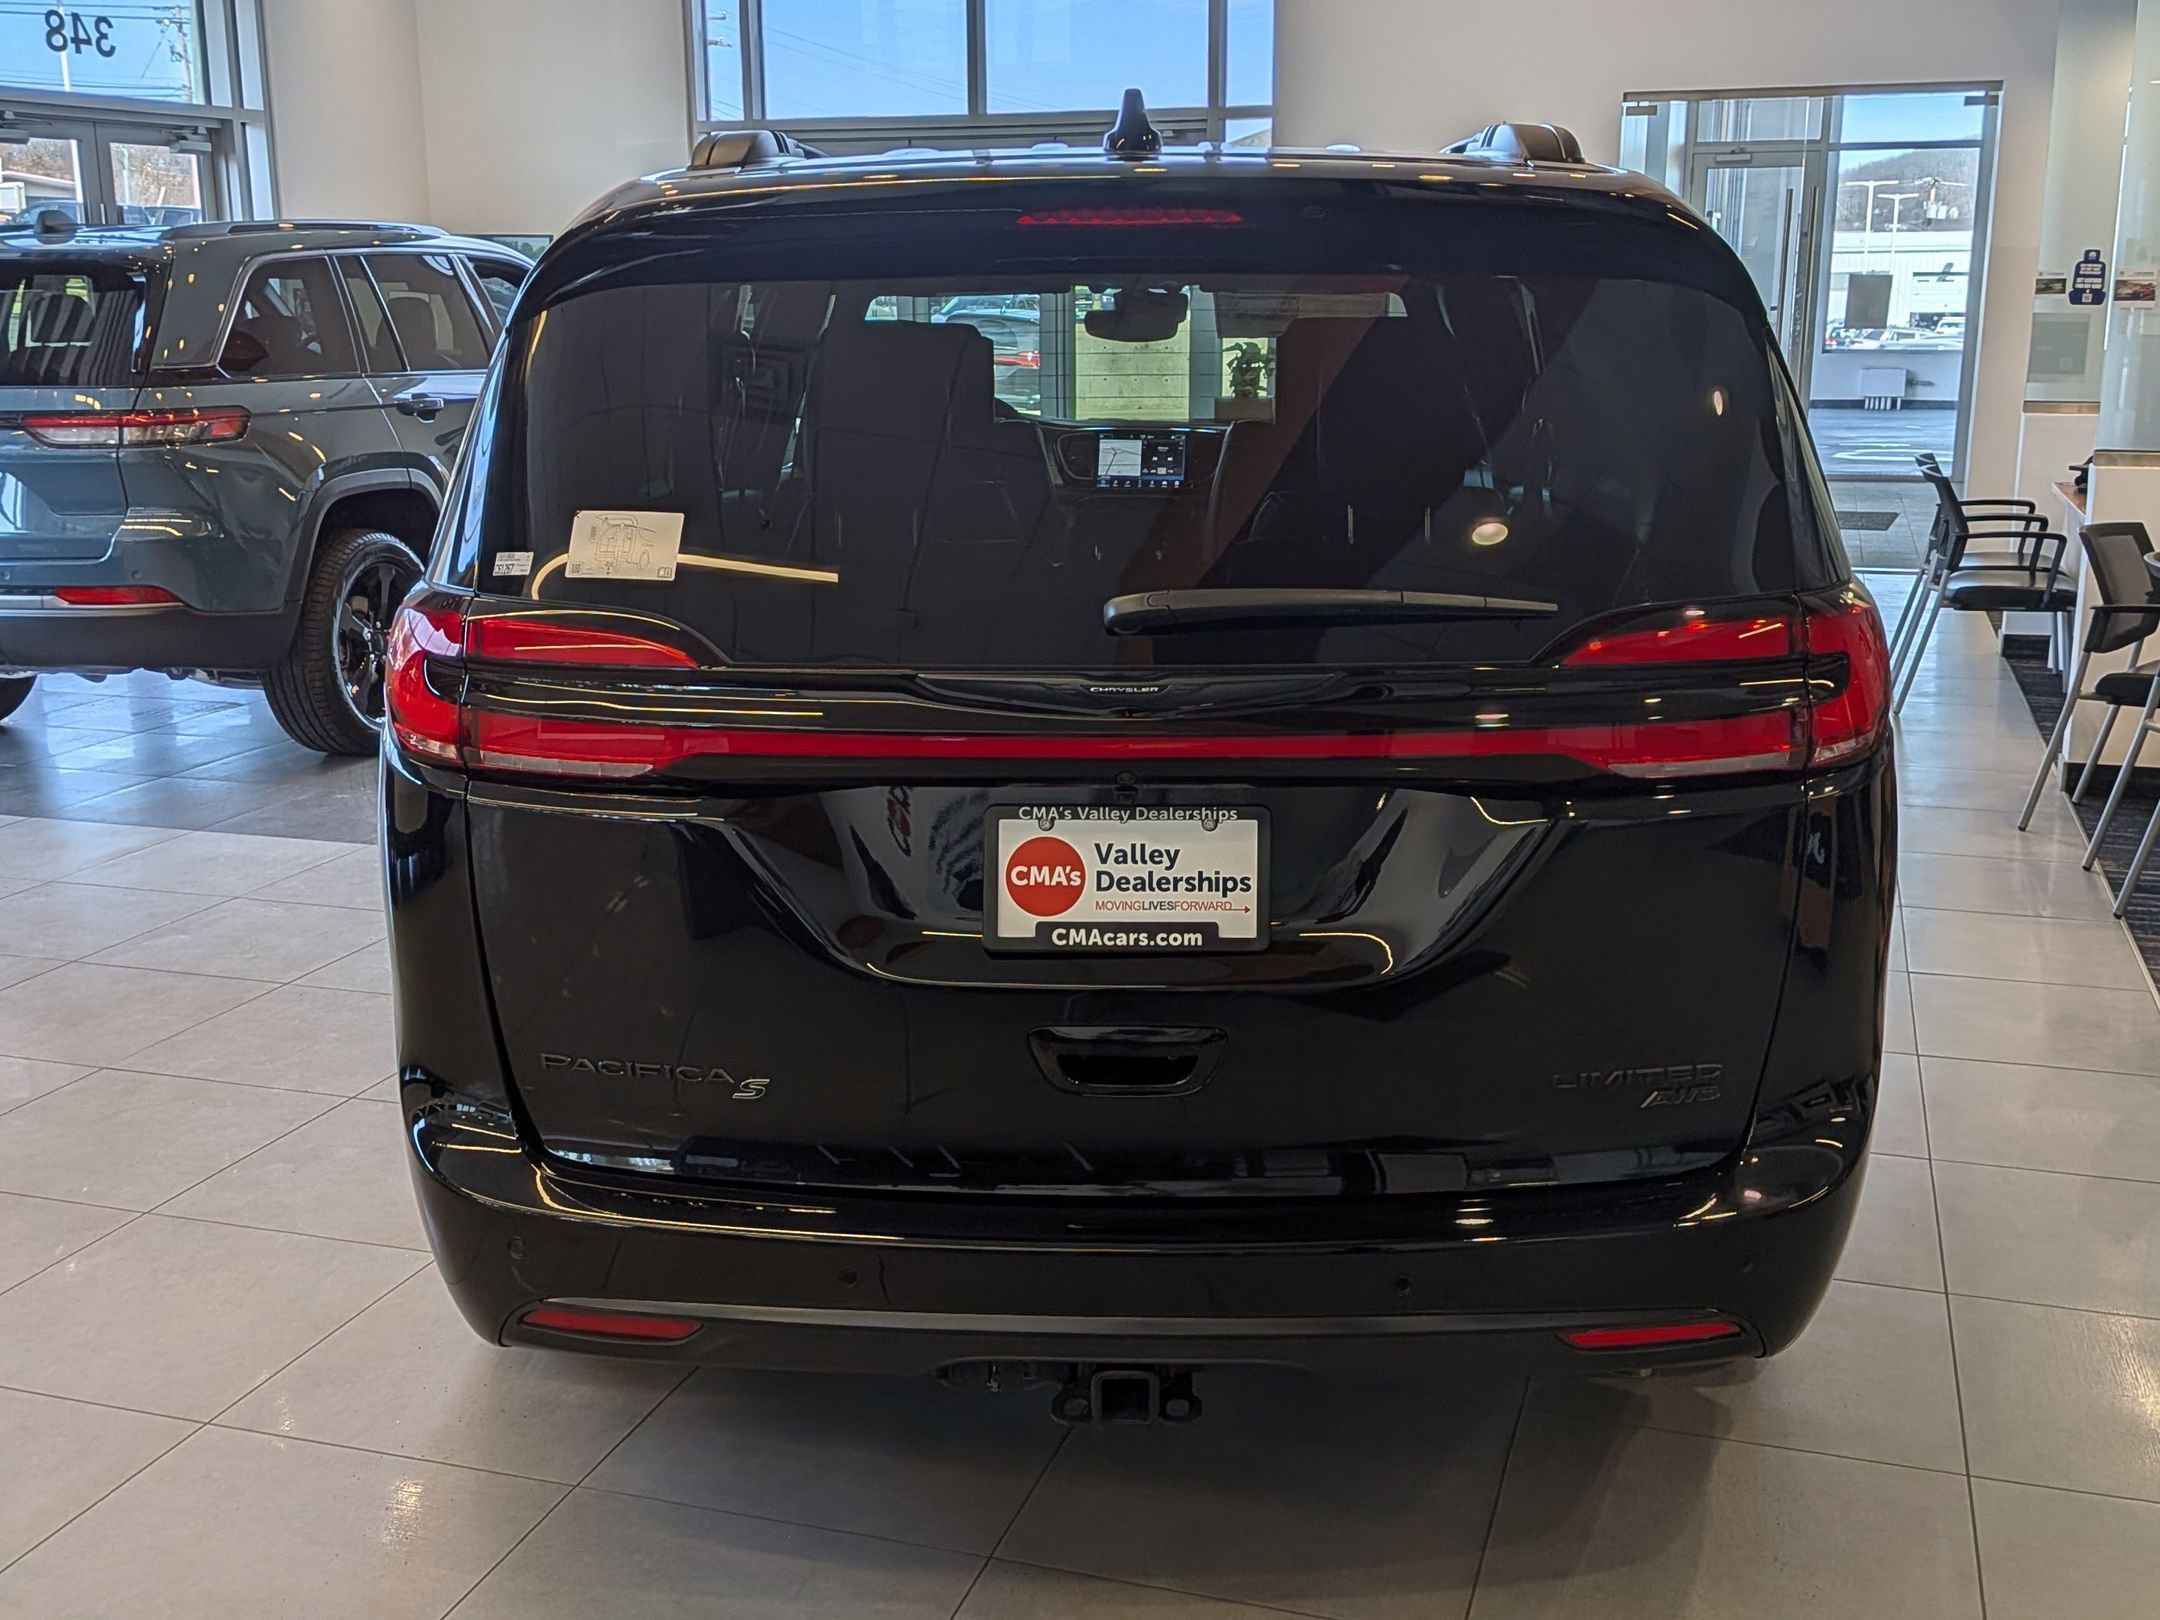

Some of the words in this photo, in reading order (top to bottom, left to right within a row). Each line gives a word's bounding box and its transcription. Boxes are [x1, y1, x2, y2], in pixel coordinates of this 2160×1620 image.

[1089, 686, 1160, 694] CHRYSLER
[1018, 805, 1073, 821] CMA's
[1077, 806, 1131, 824] Valley
[1135, 806, 1239, 822] Dealerships
[1094, 843, 1181, 871] Valley
[1010, 866, 1082, 887] CMA's
[1095, 870, 1252, 898] Dealerships
[1051, 928, 1203, 947] CMAcars.com
[540, 1053, 735, 1084] PACIFICA
[732, 1078, 770, 1100] S
[1553, 1064, 1723, 1088] LIMITED
